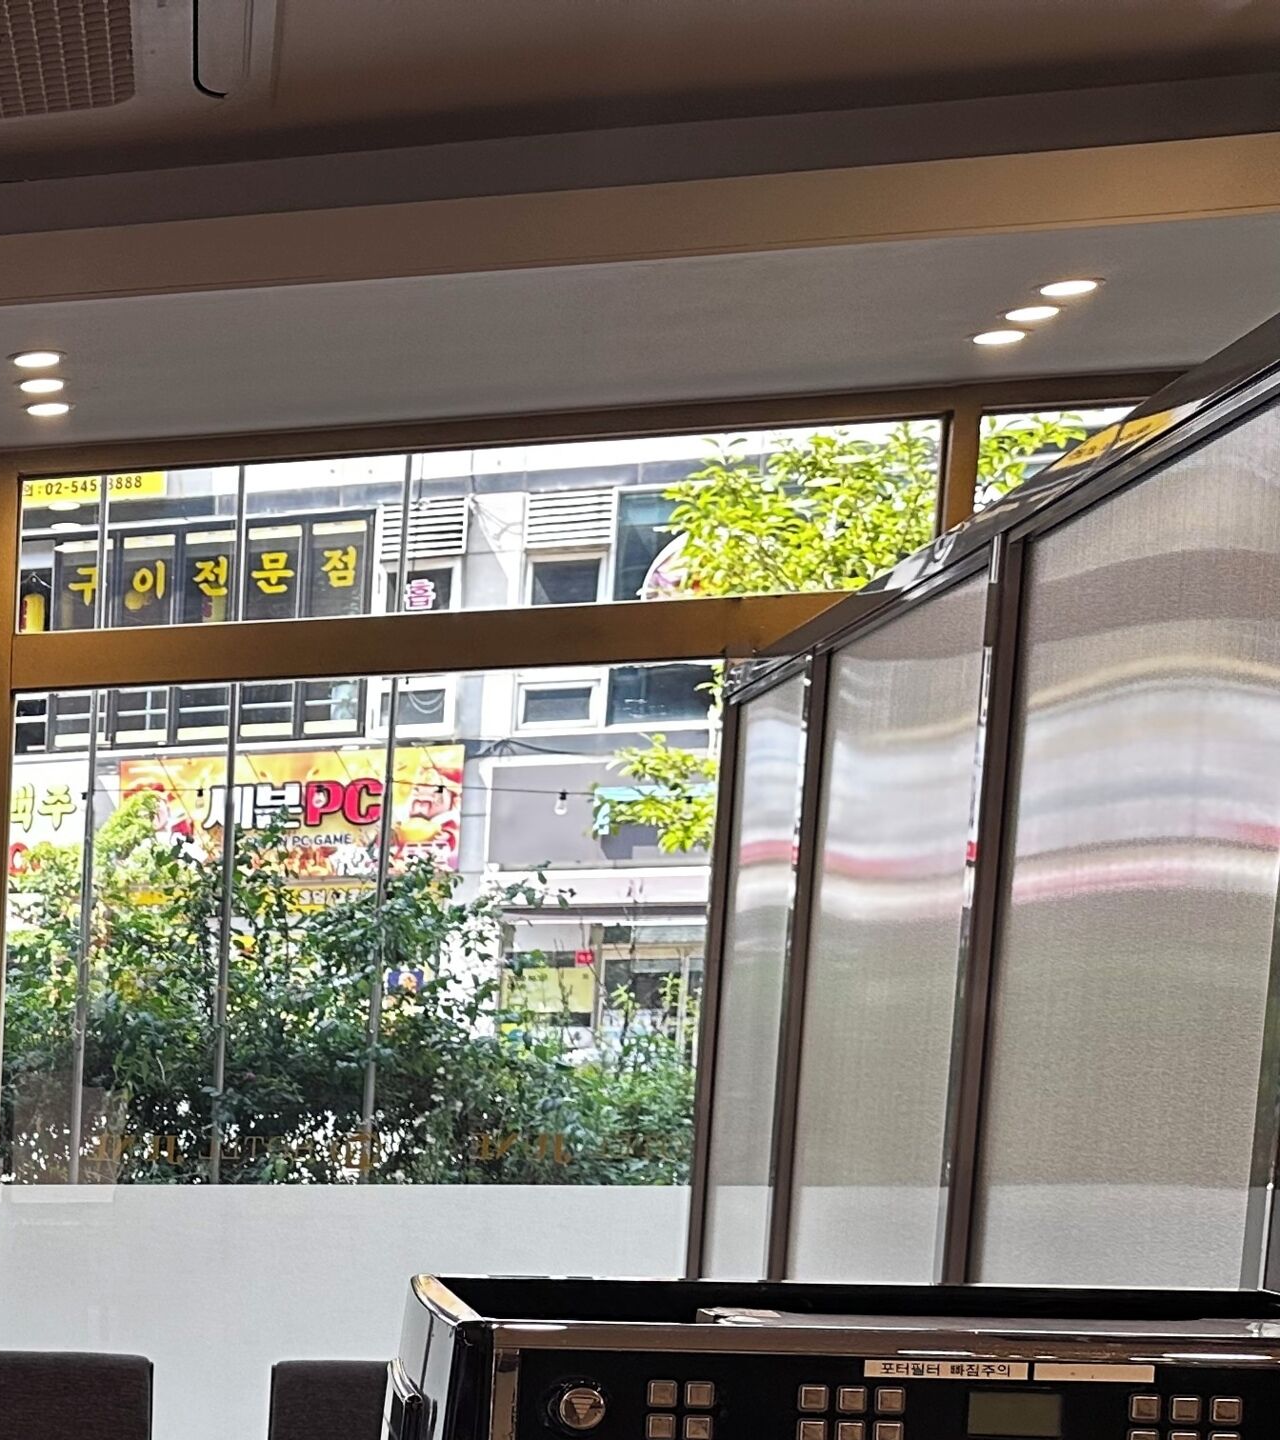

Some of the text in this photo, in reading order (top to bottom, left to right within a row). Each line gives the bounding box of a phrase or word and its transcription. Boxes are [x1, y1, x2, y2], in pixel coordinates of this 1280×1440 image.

[314, 833, 352, 846] GAME
[880, 1363, 1011, 1377] 포터필터 빠짐주의
